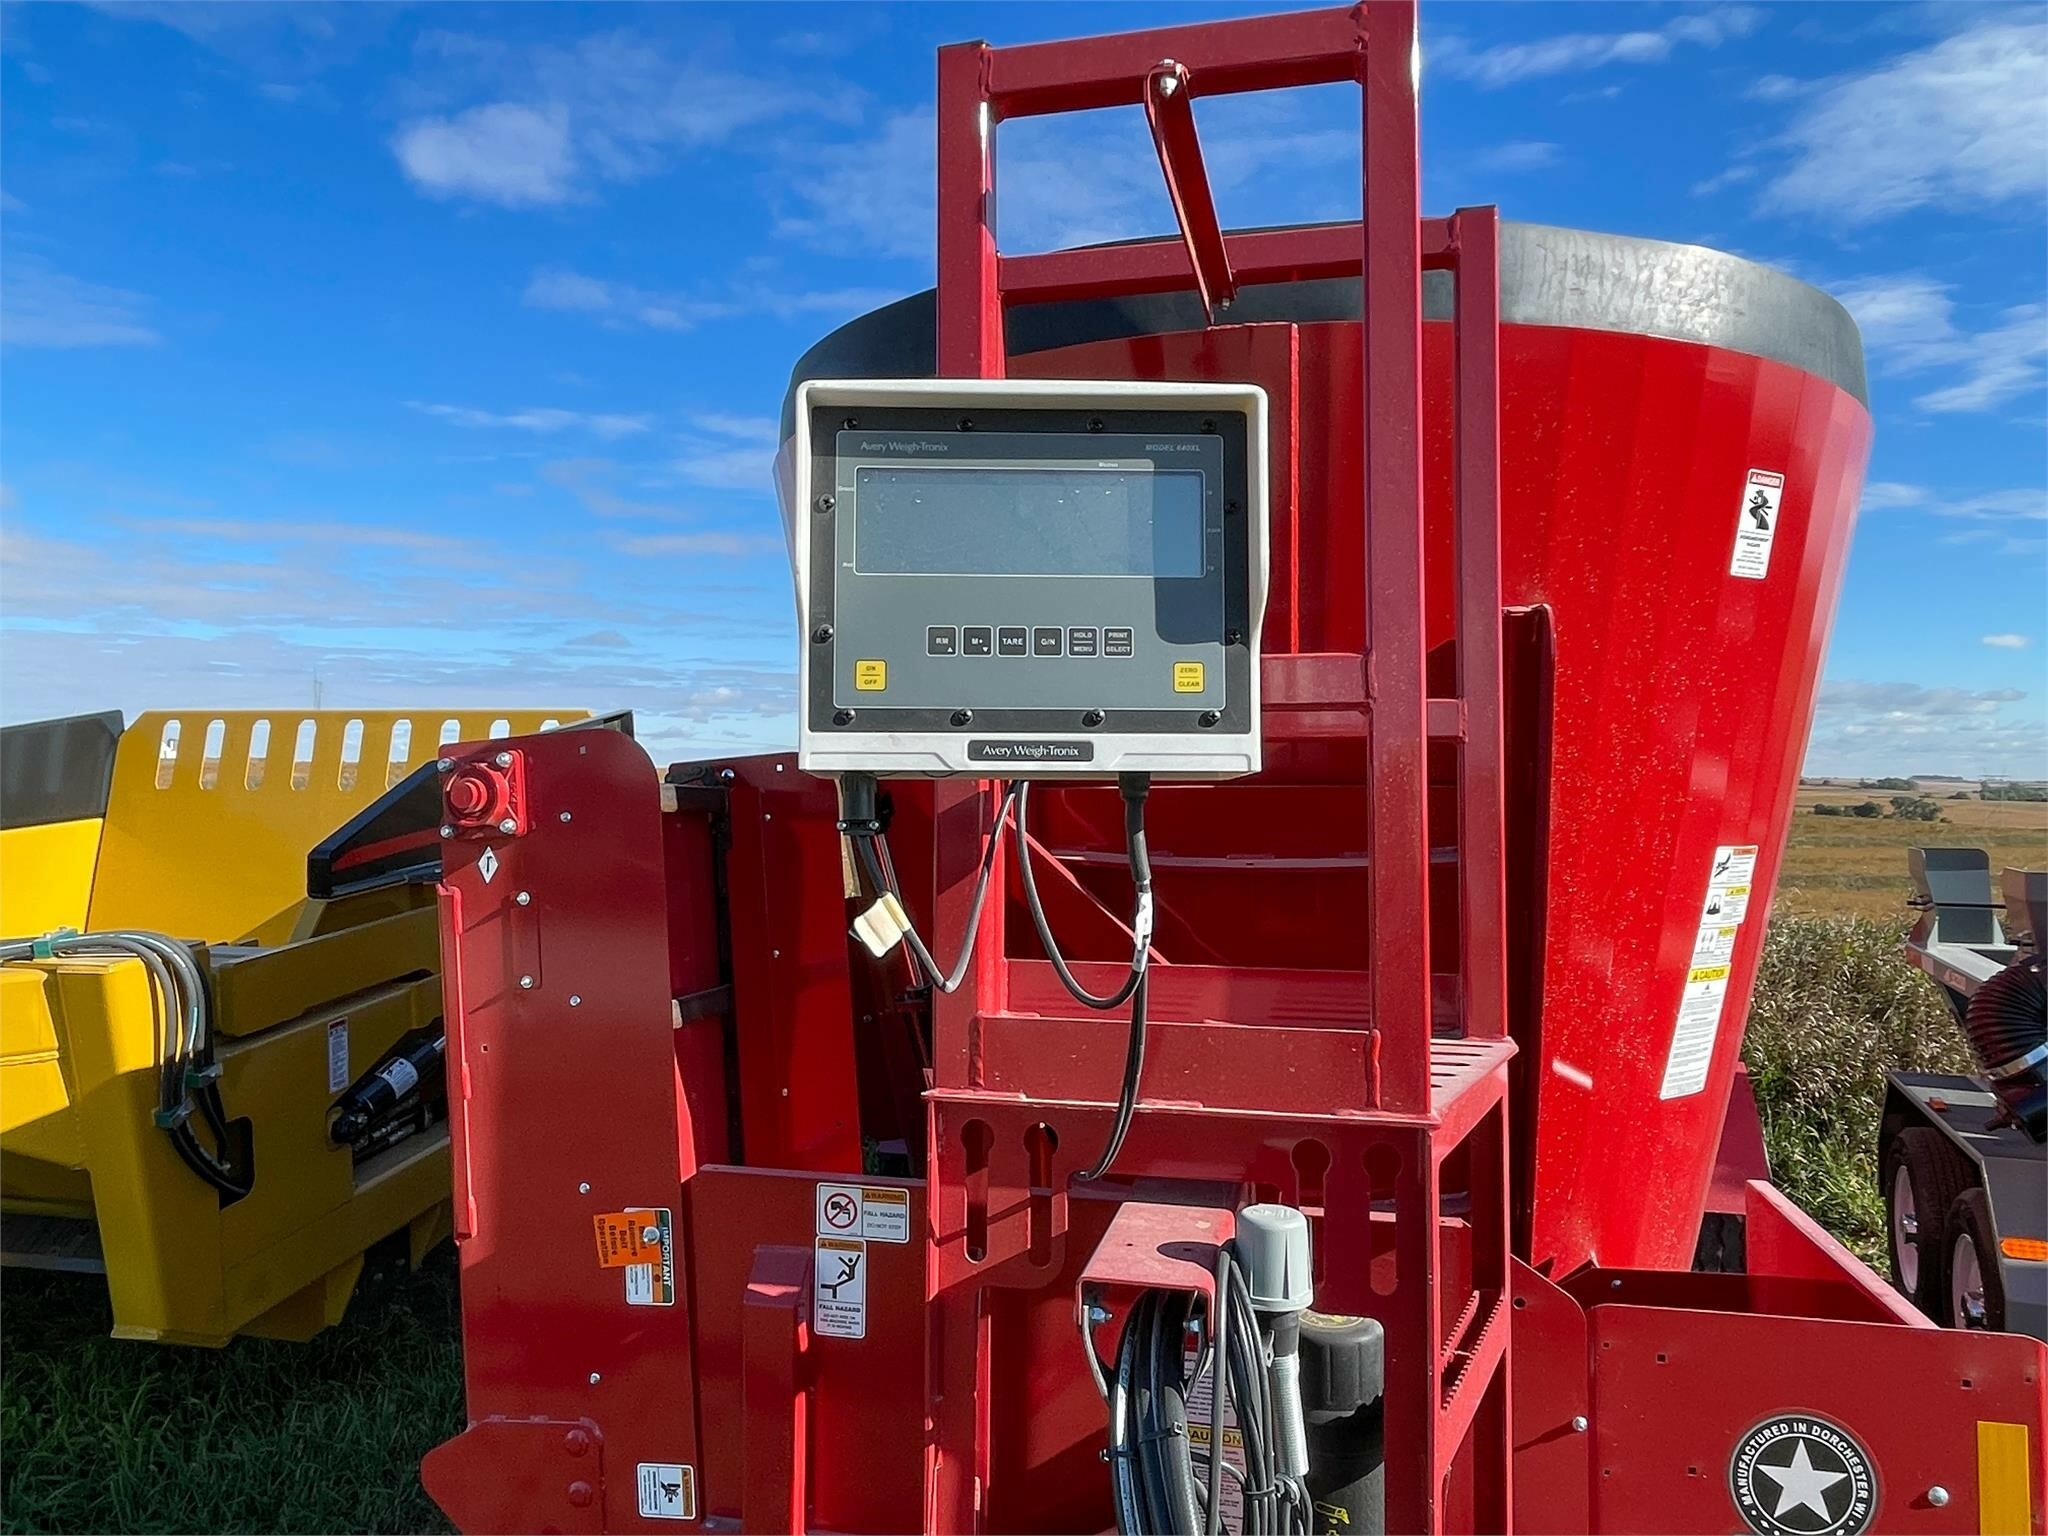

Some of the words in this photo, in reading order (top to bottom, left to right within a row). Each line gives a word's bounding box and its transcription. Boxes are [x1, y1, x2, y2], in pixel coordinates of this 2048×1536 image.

[860, 441, 887, 453] Avery
[982, 745, 1012, 757] Avery
[1014, 745, 1079, 758] Weigh-Tronix
[879, 1211, 905, 1219] HAZARD
[597, 1218, 609, 1264] Operation
[661, 1226, 671, 1287] IMPORTANT
[1737, 1423, 1789, 1506] MANUFACTURED
[1793, 1422, 1807, 1433] IN
[1811, 1425, 1869, 1498] DORCHESTER
[1852, 1502, 1867, 1519] WI
